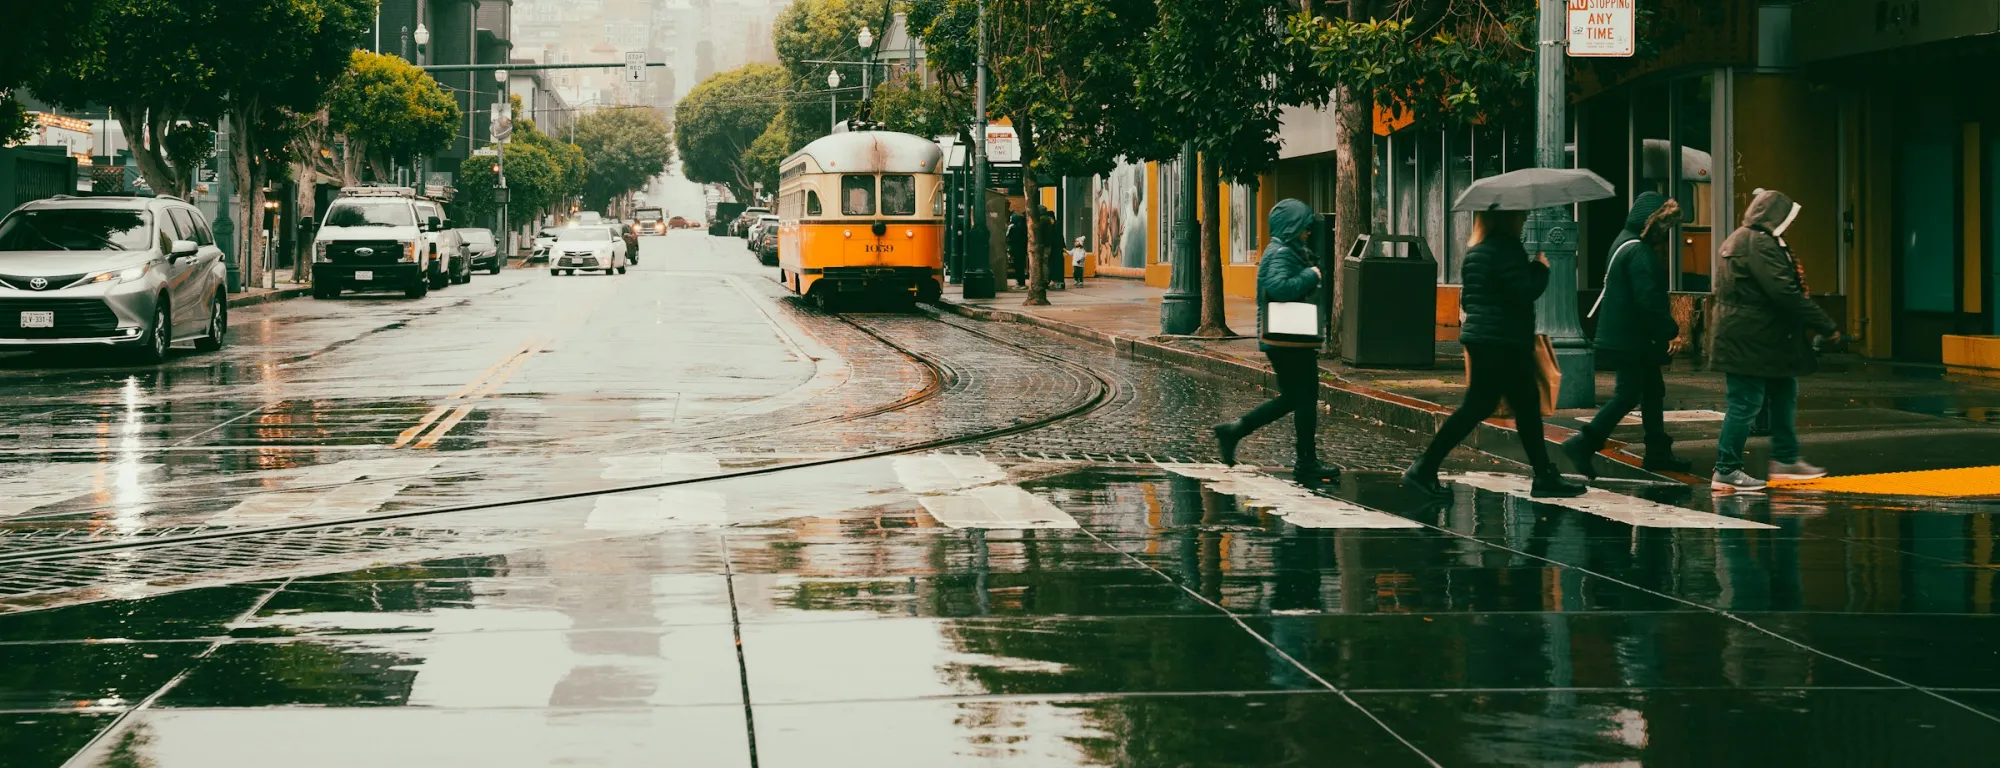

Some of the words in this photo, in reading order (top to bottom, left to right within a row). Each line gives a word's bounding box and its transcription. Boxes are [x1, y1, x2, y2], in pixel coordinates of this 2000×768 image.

[1590, 0, 1629, 8] STOPPING
[1588, 13, 1612, 24] ANY
[1587, 28, 1614, 39] TIME
[865, 244, 893, 252] 1059
